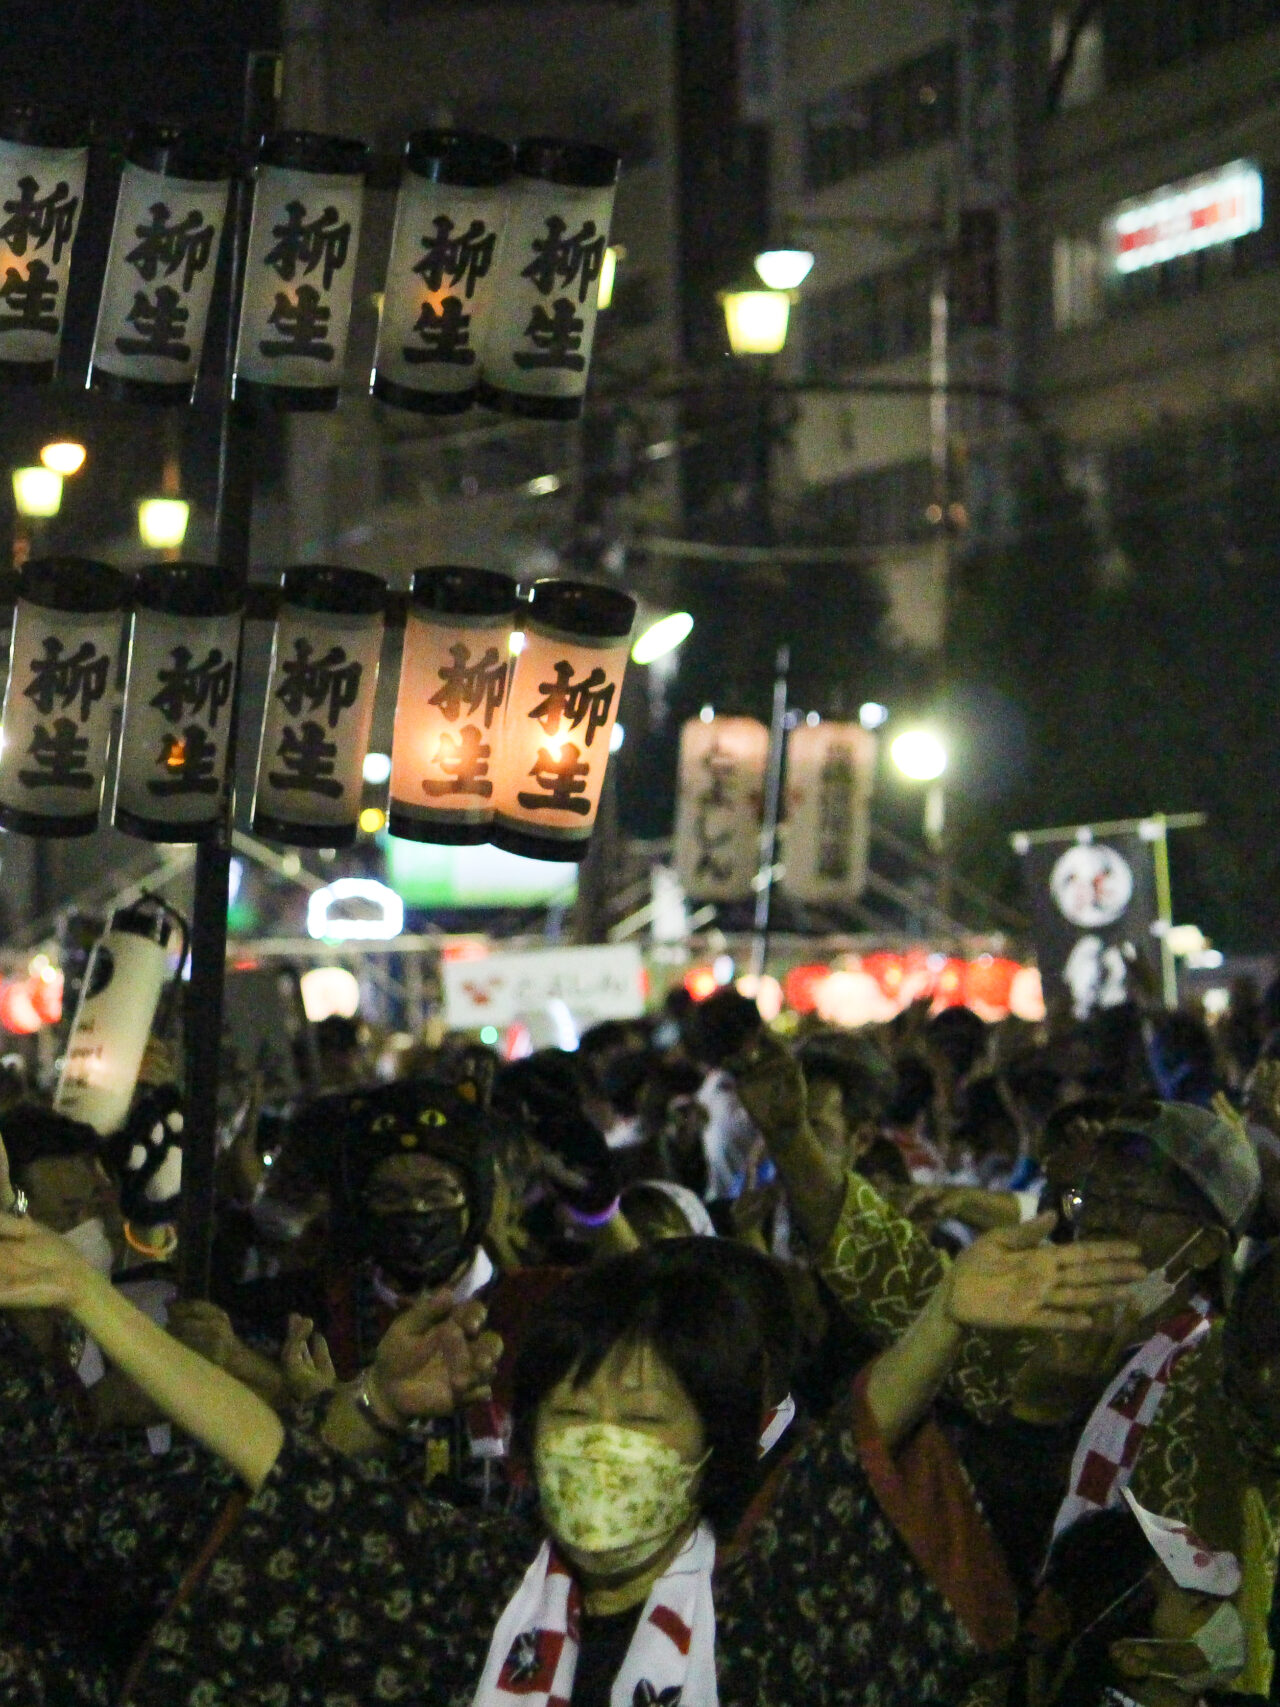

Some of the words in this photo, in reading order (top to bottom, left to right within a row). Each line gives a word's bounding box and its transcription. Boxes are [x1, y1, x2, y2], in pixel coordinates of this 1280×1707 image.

[114, 202, 215, 362] 柳生
[259, 203, 352, 362] 柳生
[402, 215, 497, 366] 柳生
[513, 215, 605, 371] 柳生
[18, 636, 110, 793] 柳生
[147, 645, 232, 797] 柳生
[269, 637, 363, 798] 柳生
[422, 642, 508, 799] 柳生
[517, 659, 616, 815] 柳生
